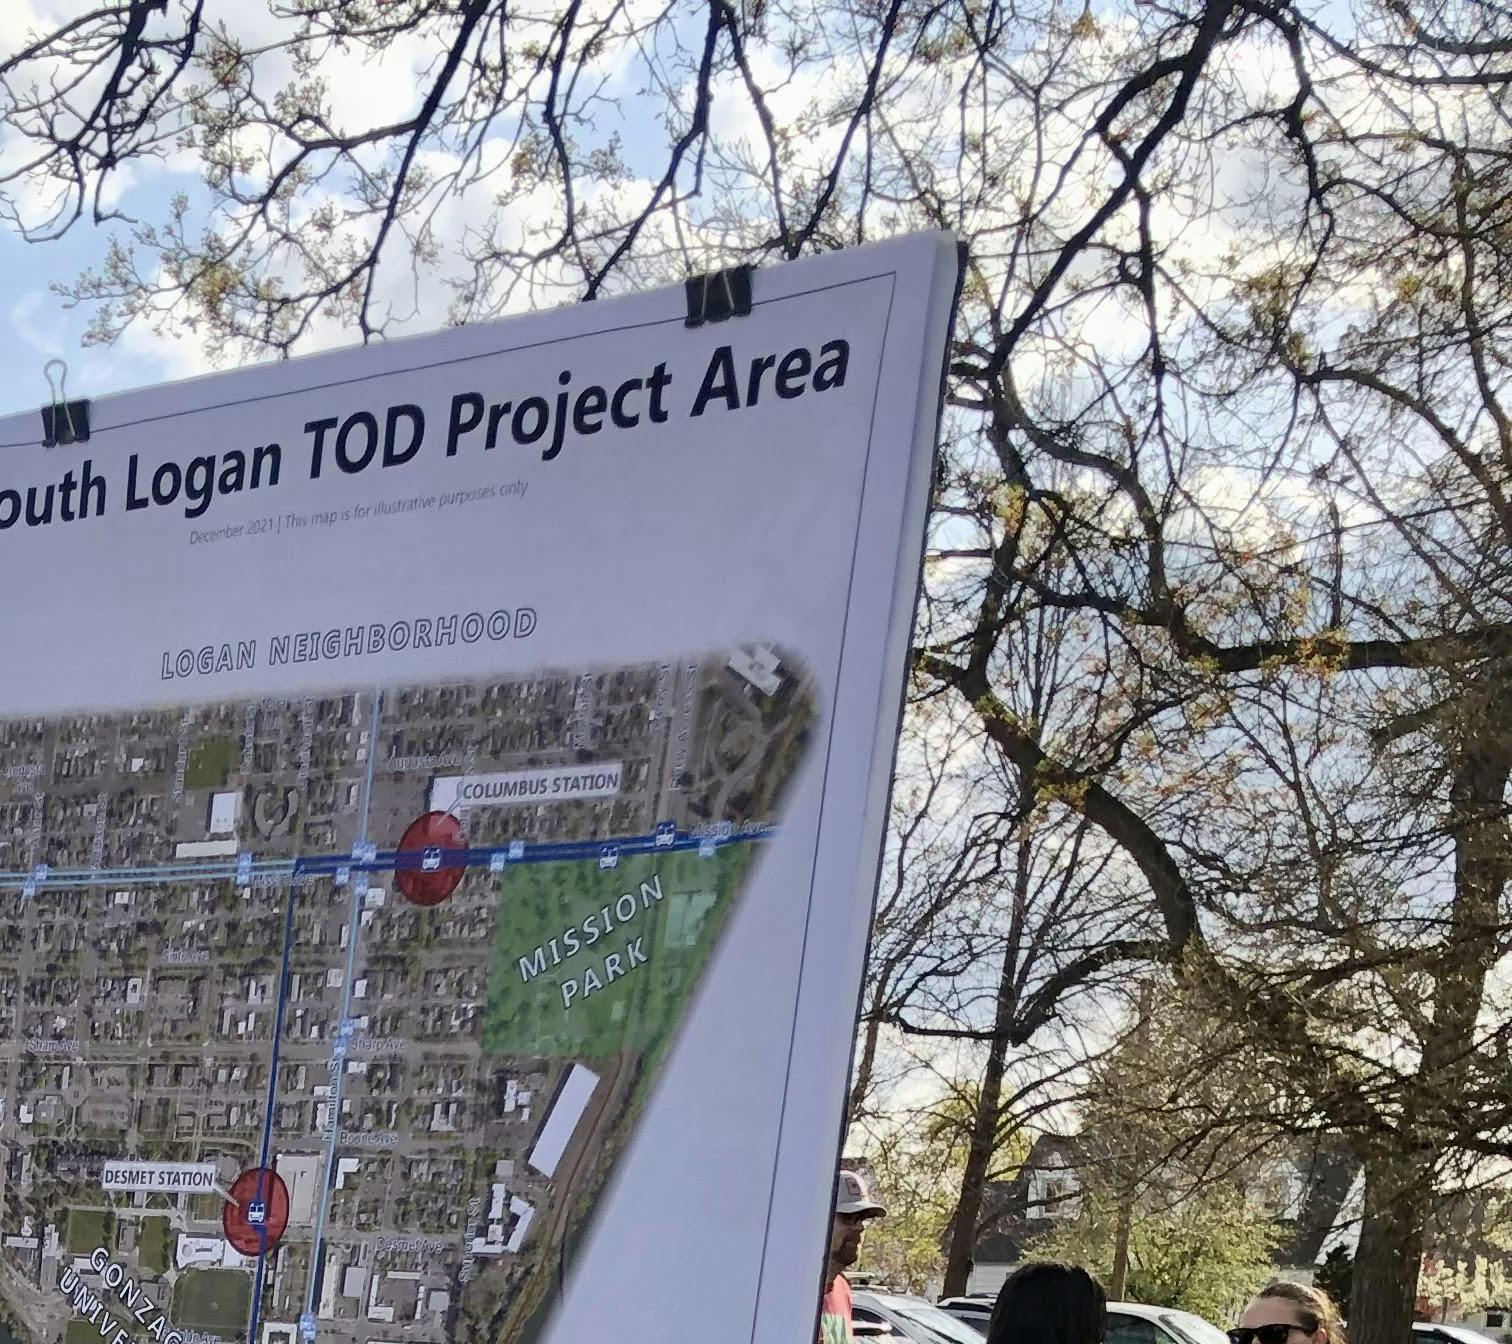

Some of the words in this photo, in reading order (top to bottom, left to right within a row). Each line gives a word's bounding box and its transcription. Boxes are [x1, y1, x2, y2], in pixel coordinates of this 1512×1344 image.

[124, 442, 283, 520] Logan
[303, 403, 426, 480] TOD
[445, 361, 673, 462] Project
[688, 337, 852, 418] Area
[189, 523, 244, 546] December
[246, 516, 274, 537] 2021
[284, 512, 308, 531] This
[310, 510, 337, 533] map
[340, 507, 351, 525] is
[353, 504, 371, 523] for
[373, 492, 437, 519] illustrative
[437, 484, 497, 512] purposes
[498, 478, 529, 501] only
[159, 637, 256, 682] LOGAN
[268, 606, 540, 667] NEIGHBORHOOD
[462, 775, 548, 801] COLUMBUS
[551, 771, 620, 796] STATION
[518, 874, 665, 983] MISSION
[558, 936, 649, 1009] PARK
[104, 1169, 155, 1186] DESMET
[157, 1171, 214, 1188] STATION
